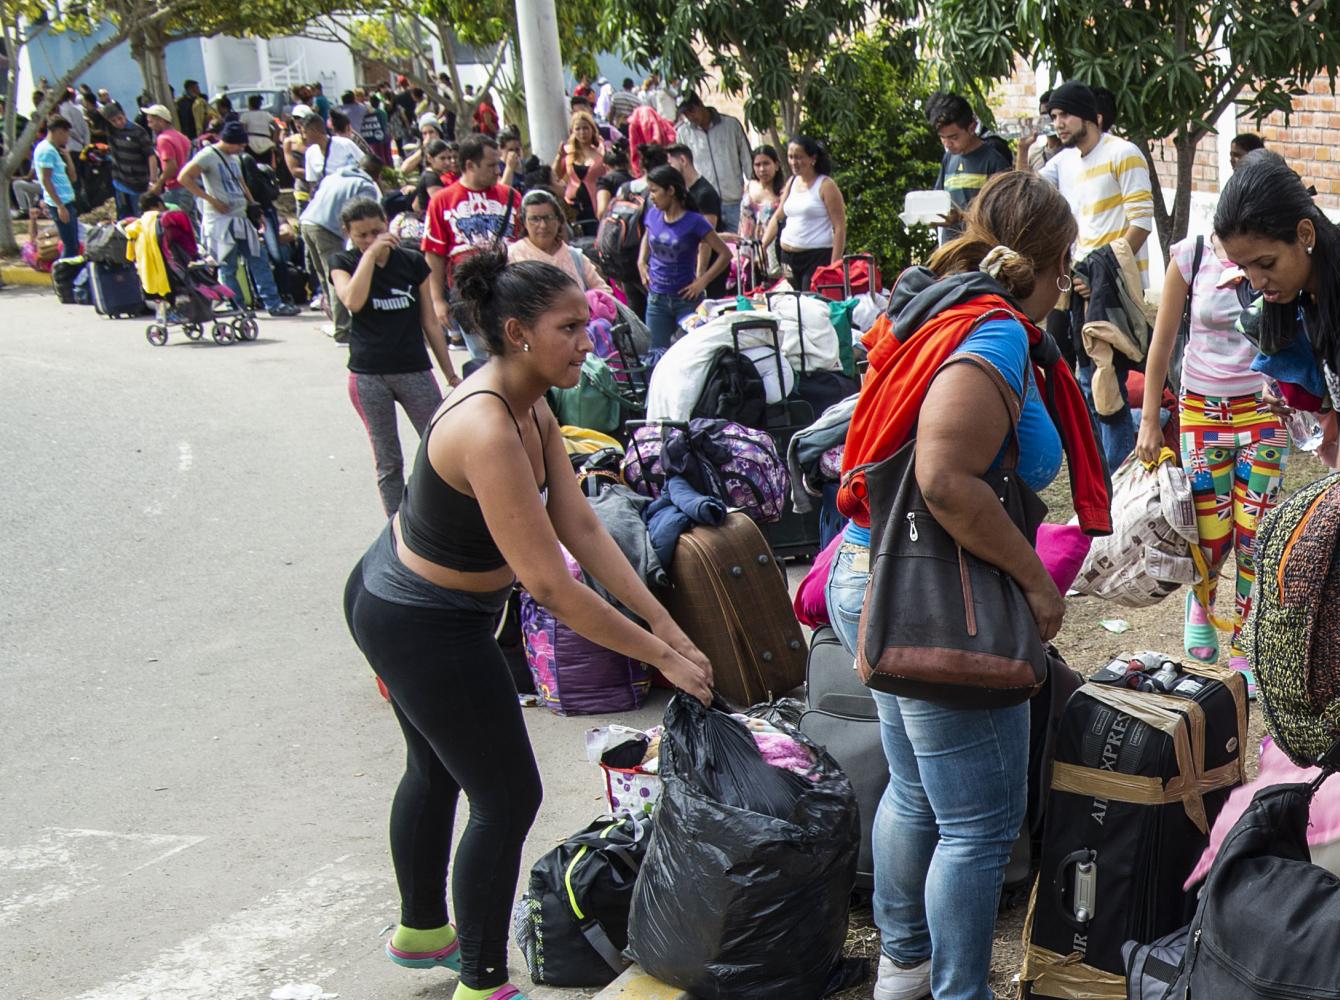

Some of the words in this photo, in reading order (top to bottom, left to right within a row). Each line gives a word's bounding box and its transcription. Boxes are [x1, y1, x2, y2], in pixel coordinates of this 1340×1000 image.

[372, 296, 410, 311] PUMA
[1091, 797, 1109, 825] AI
[1100, 711, 1133, 772] XPRES
[1072, 933, 1088, 958] IR
